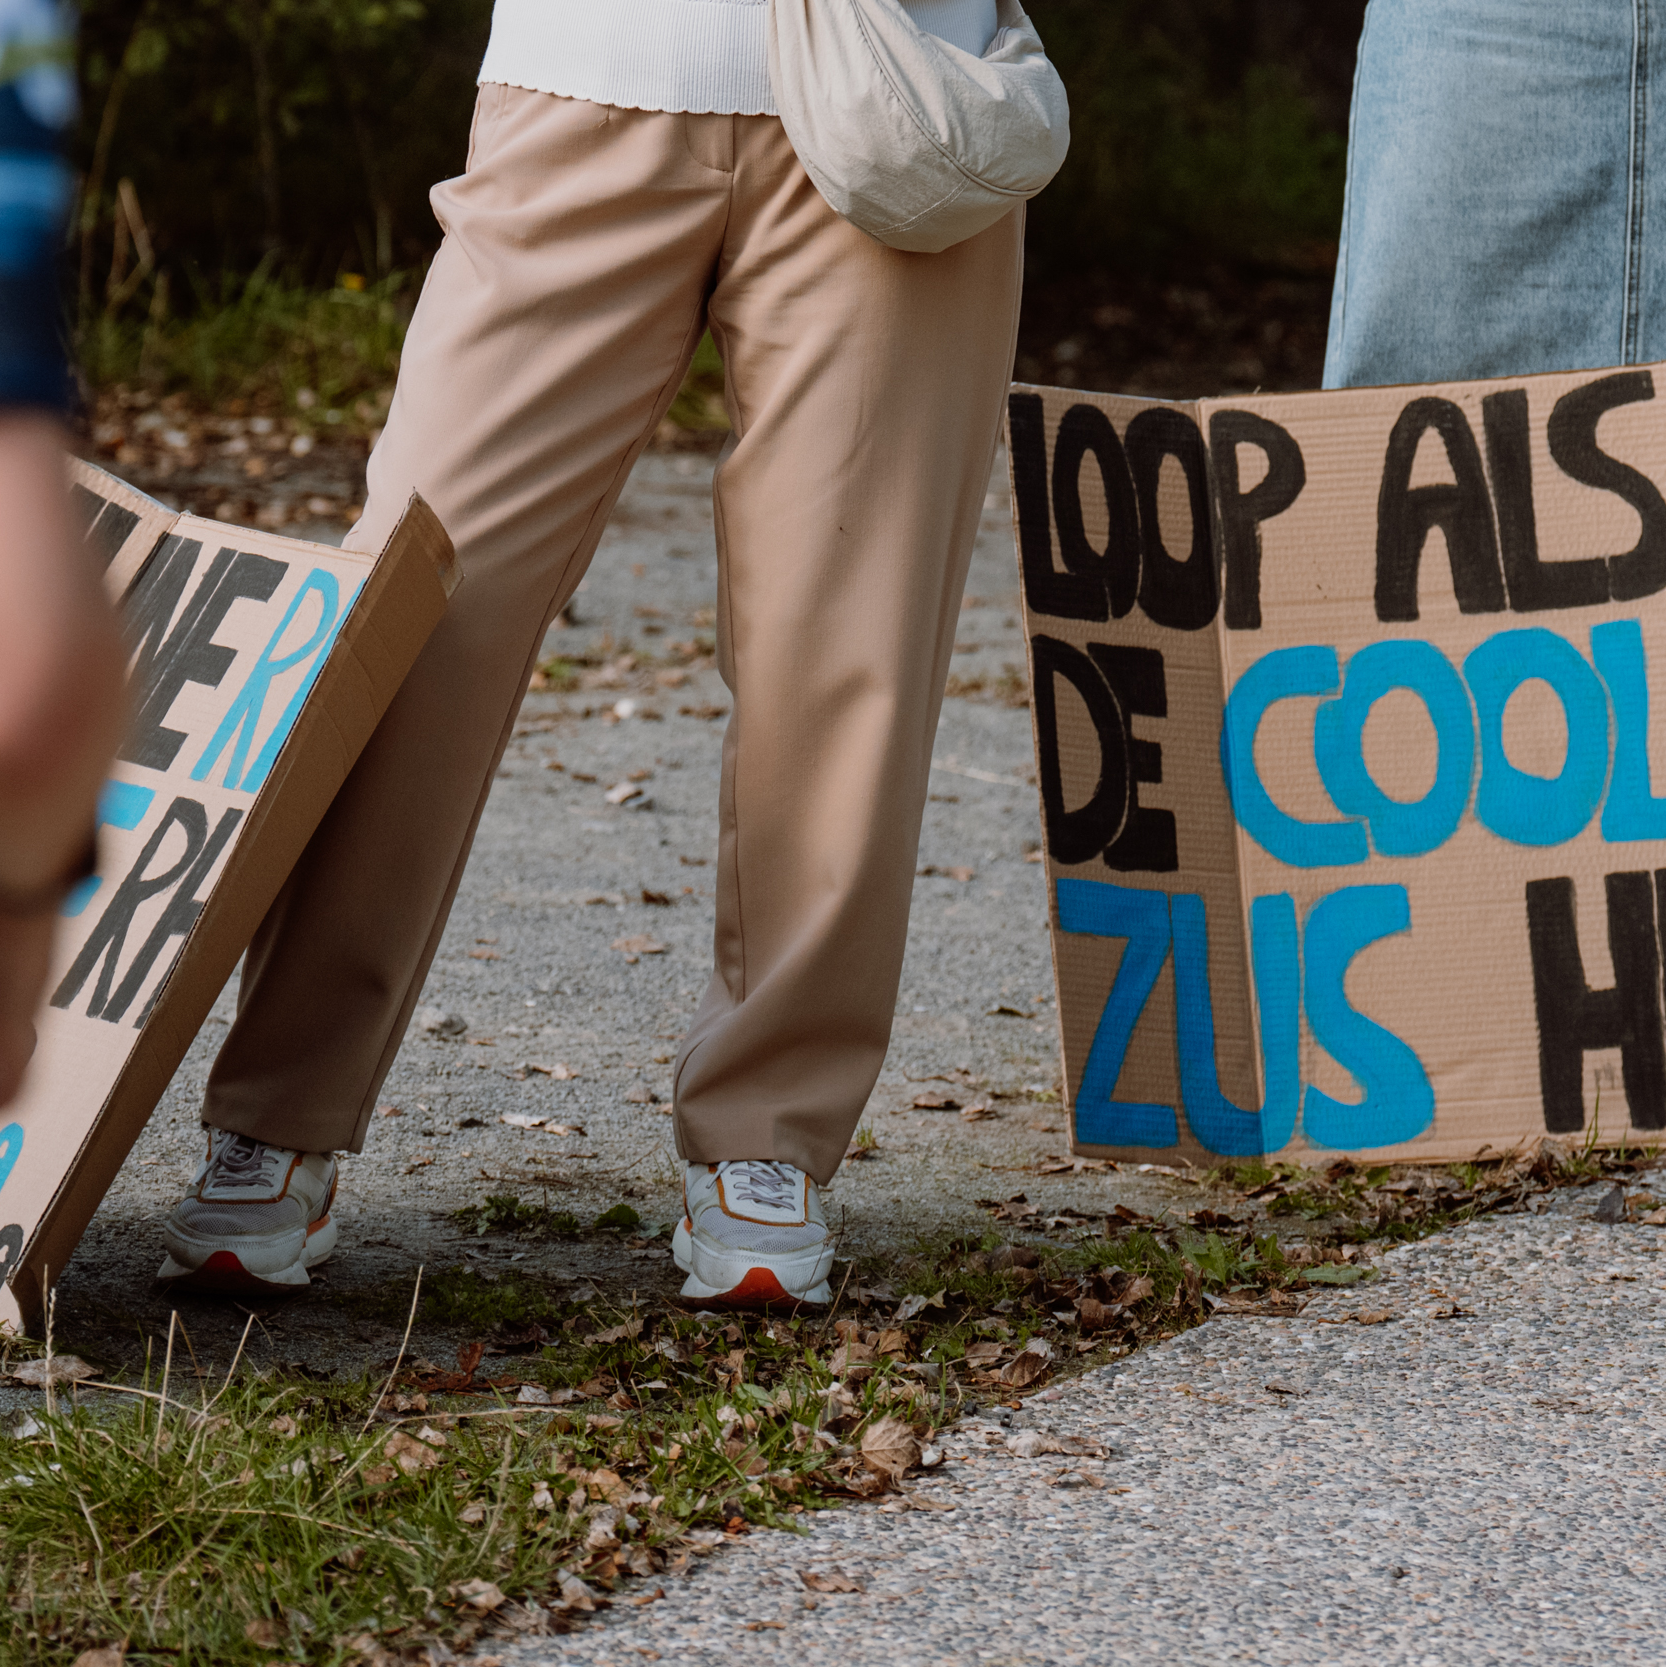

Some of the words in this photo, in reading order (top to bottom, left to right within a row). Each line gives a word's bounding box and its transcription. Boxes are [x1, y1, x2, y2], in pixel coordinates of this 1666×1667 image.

[1007, 392, 1307, 630] LOOP
[1031, 634, 1179, 872] DE
[1055, 878, 1436, 1157] ZUS
